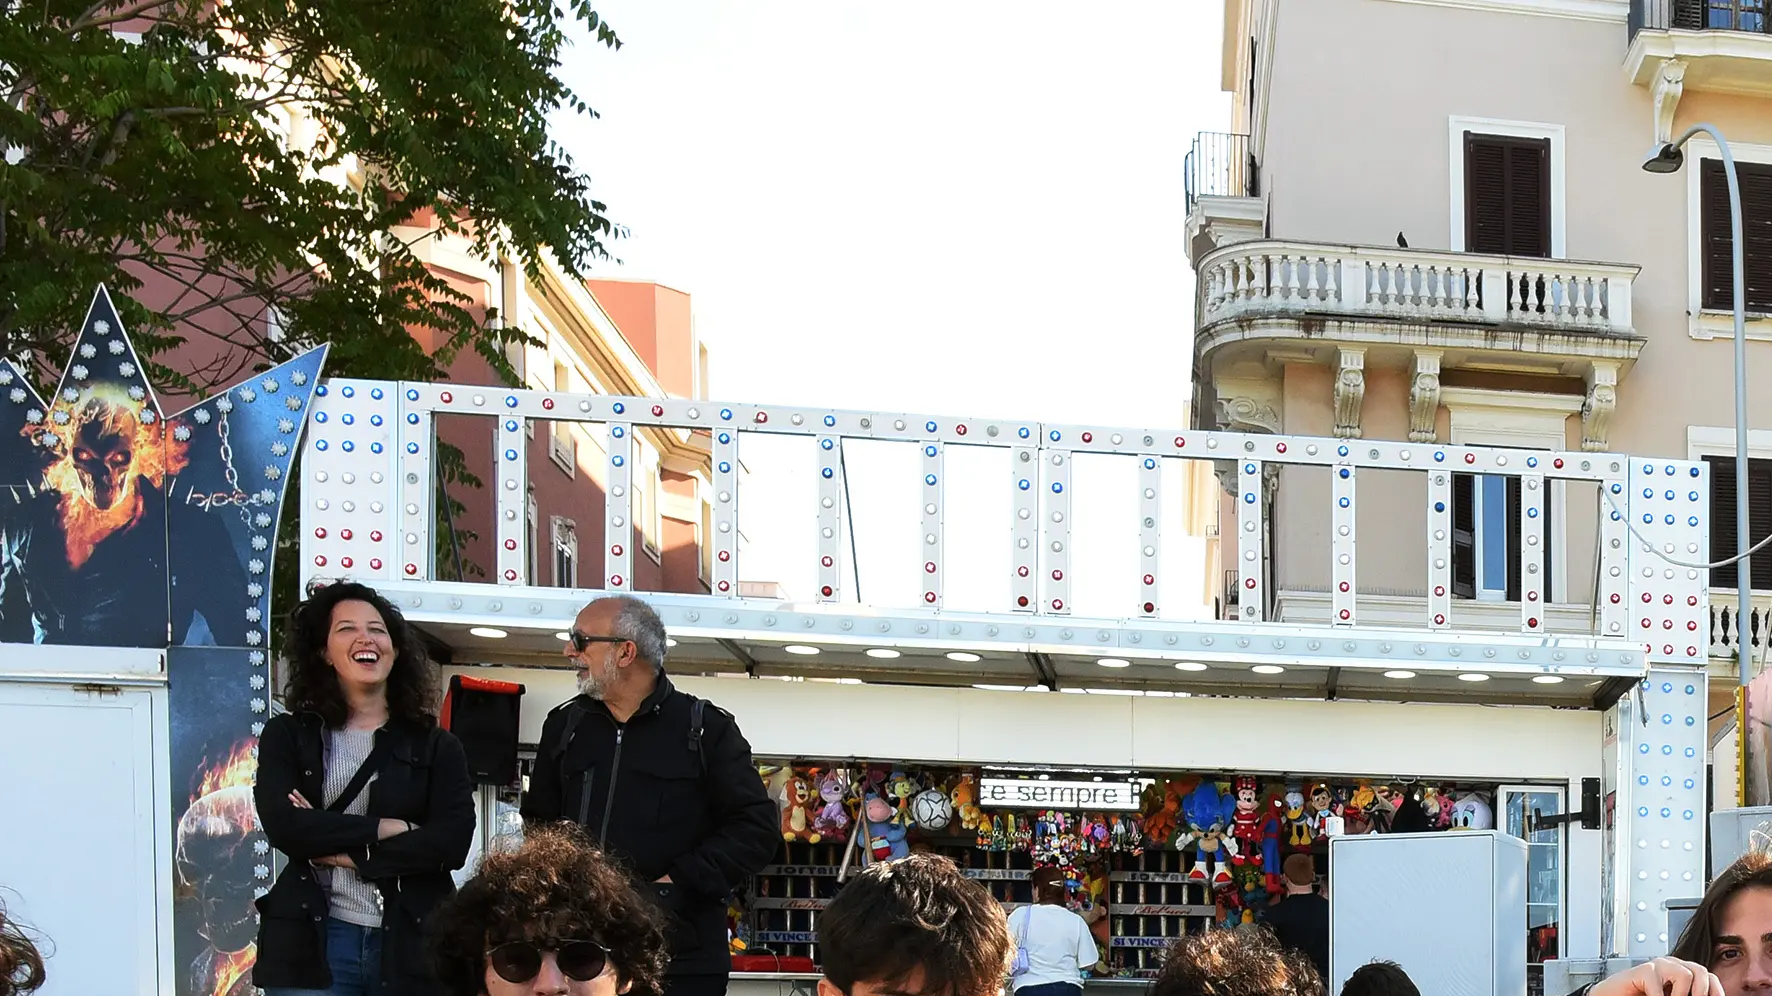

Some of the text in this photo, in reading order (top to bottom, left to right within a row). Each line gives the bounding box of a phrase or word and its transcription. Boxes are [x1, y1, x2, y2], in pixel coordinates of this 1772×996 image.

[1018, 786, 1118, 808] sempre
[773, 932, 812, 942] VINCE
[1129, 938, 1167, 948] VINCE
